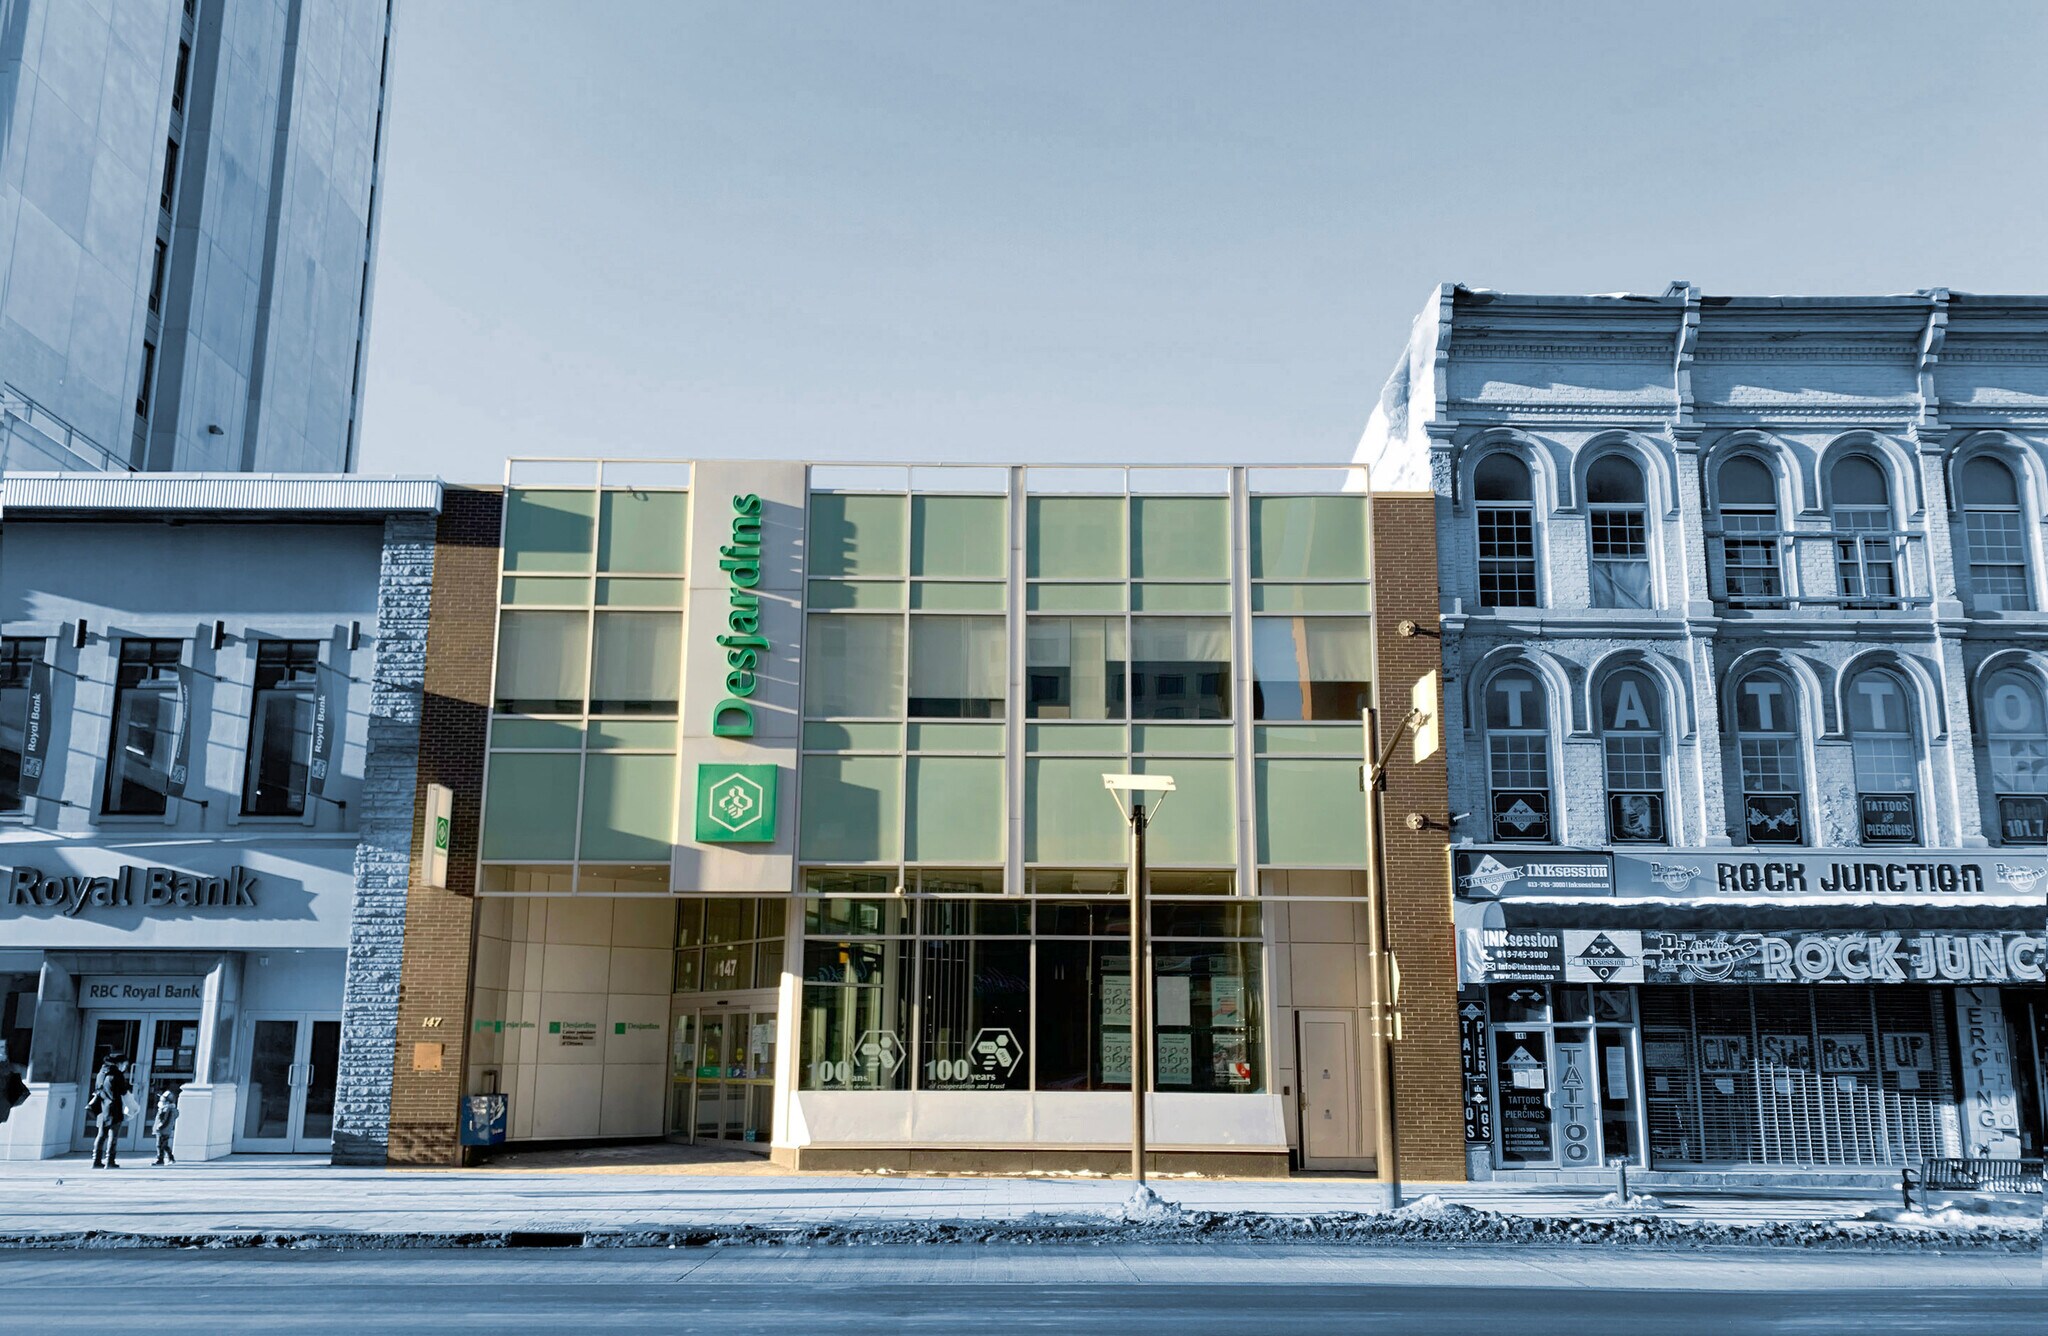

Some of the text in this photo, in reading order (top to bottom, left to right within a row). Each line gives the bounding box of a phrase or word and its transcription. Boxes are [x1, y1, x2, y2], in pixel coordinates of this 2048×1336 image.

[712, 493, 770, 737] Desjardins
[31, 693, 41, 719] Bank
[317, 694, 326, 718] Bank
[27, 721, 39, 752] Royal
[314, 722, 325, 753] Royal
[1865, 801, 1909, 812] TATTOOS
[2004, 801, 2043, 820] Rebel
[1866, 824, 1913, 836] PIERCINGS
[2007, 819, 2044, 837] 101.7
[1527, 863, 1608, 878] INKsession
[1652, 866, 1701, 881] Martens
[1717, 862, 1808, 892] ROCK
[1997, 866, 2046, 884] Martens
[8, 865, 257, 916] Royal Bank
[1484, 930, 1558, 948] INKsession
[1660, 934, 1757, 962] Dr. Martens
[1496, 950, 1549, 959] 613-745-3000
[1762, 937, 2047, 980] ROCK JUNC
[719, 959, 737, 977] 147
[1494, 972, 1554, 980] www.inksession.ca
[90, 984, 201, 1001] RBC Royal Bank
[421, 1017, 442, 1028] 147
[851, 1074, 868, 1082] ans
[925, 1060, 996, 1083] 100 years
[1476, 1021, 1490, 1138] PIERNGS
[1508, 1096, 1541, 1104] TATTOOS
[1560, 1047, 1590, 1161] TATTOO
[1505, 1110, 1545, 1119] PIERCINGS
